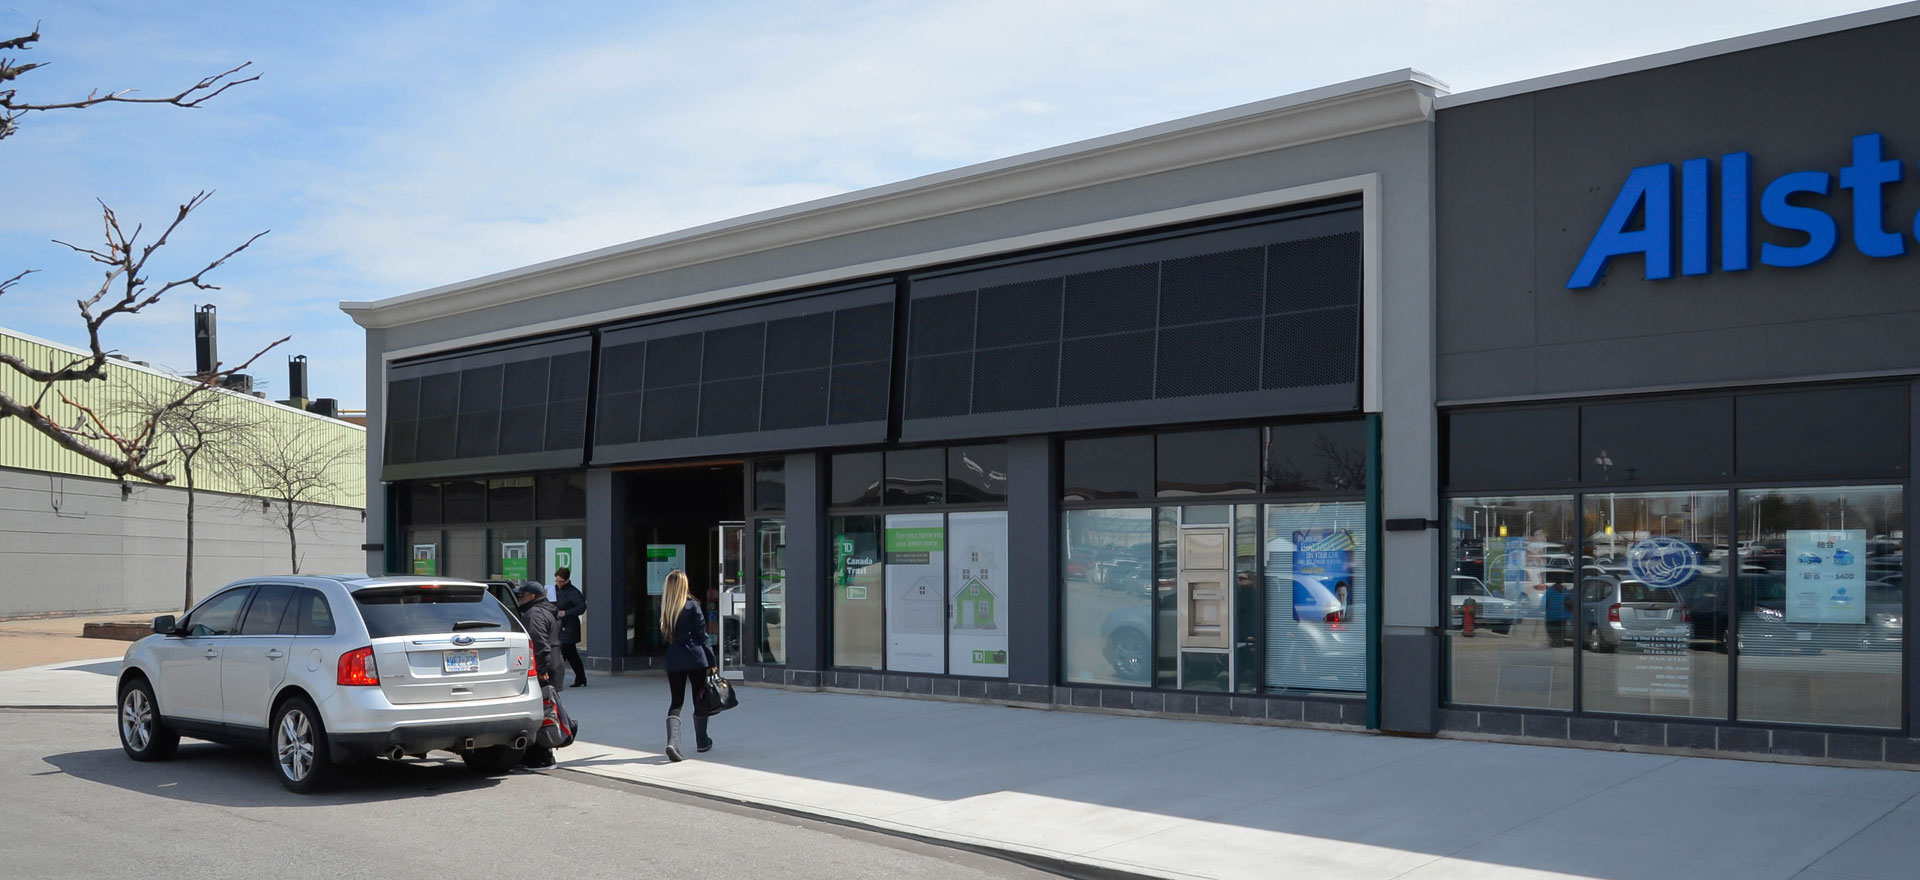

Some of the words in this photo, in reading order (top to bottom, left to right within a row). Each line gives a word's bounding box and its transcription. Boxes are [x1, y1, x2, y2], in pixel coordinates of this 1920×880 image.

[1566, 131, 1920, 289] Allst
[556, 552, 571, 568] TD
[846, 557, 873, 565] Canada
[846, 567, 866, 575] Trust
